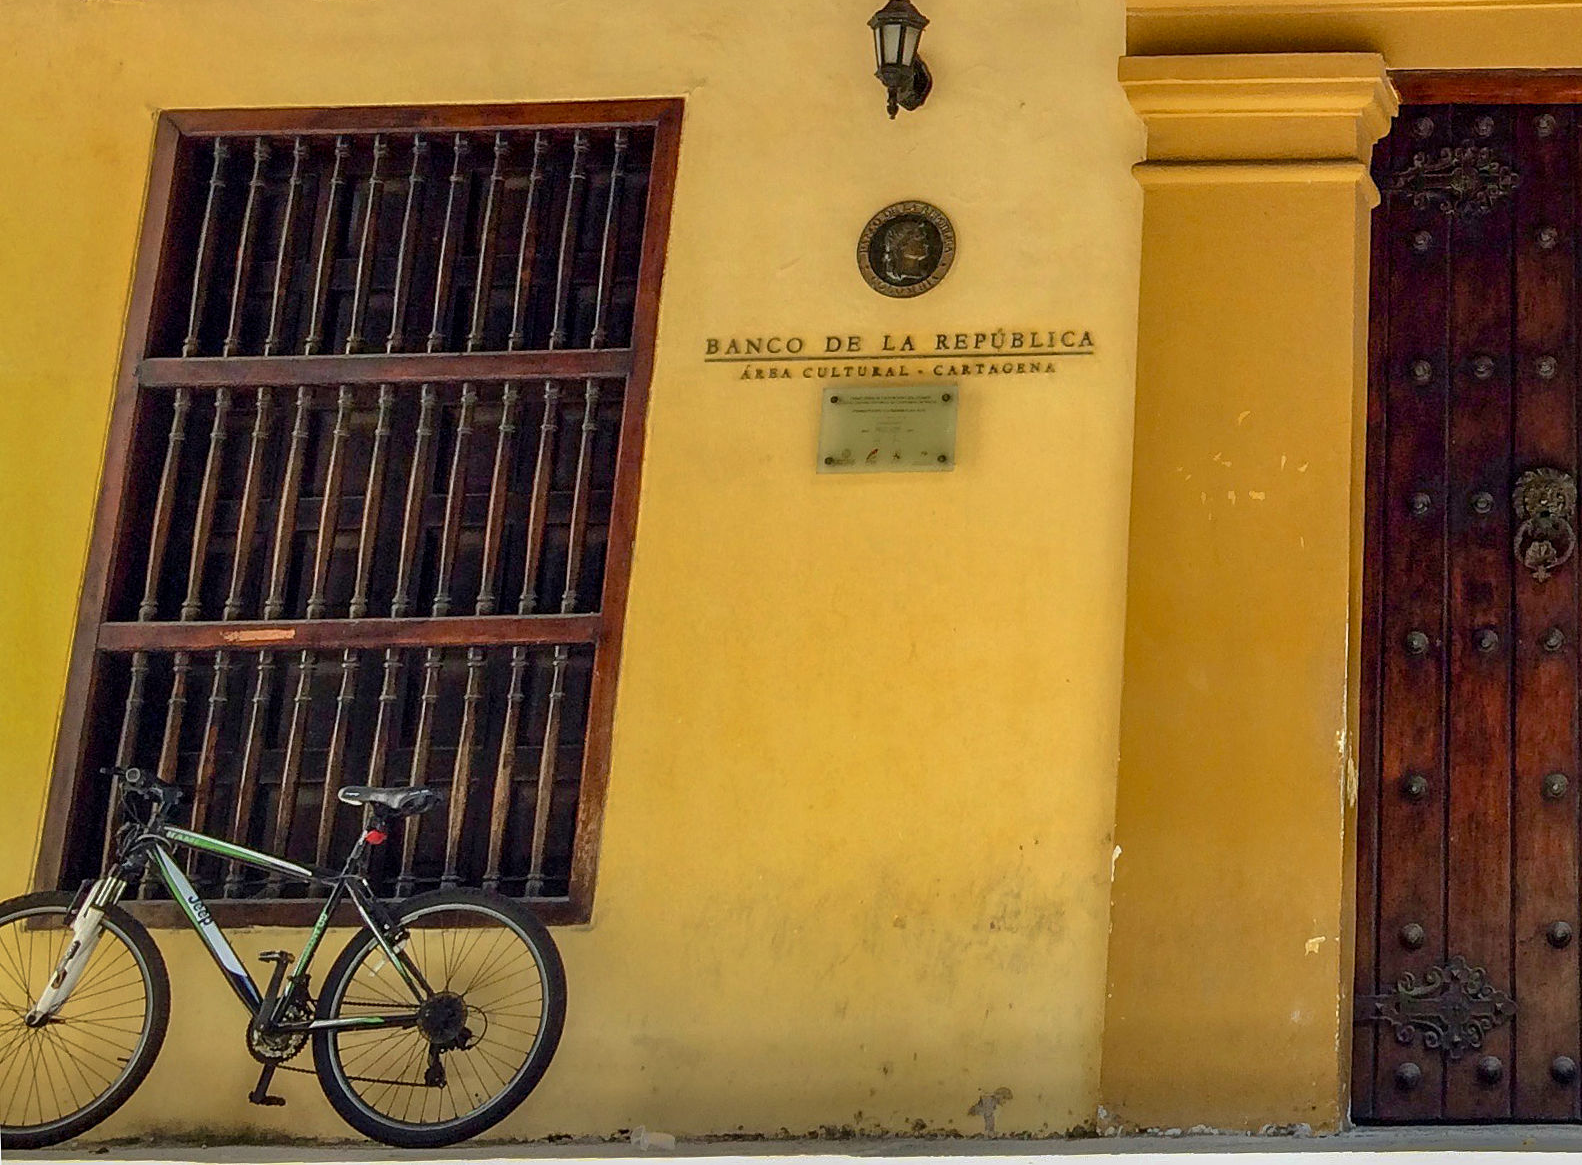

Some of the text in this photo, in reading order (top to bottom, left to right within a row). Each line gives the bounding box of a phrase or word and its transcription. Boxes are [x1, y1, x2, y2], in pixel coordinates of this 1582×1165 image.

[705, 328, 1095, 355] BANCO DE LA REPÚBLICA
[740, 362, 1056, 380] ÁREA CULTURAL CARTAGENA
[187, 895, 214, 926] Jeep
